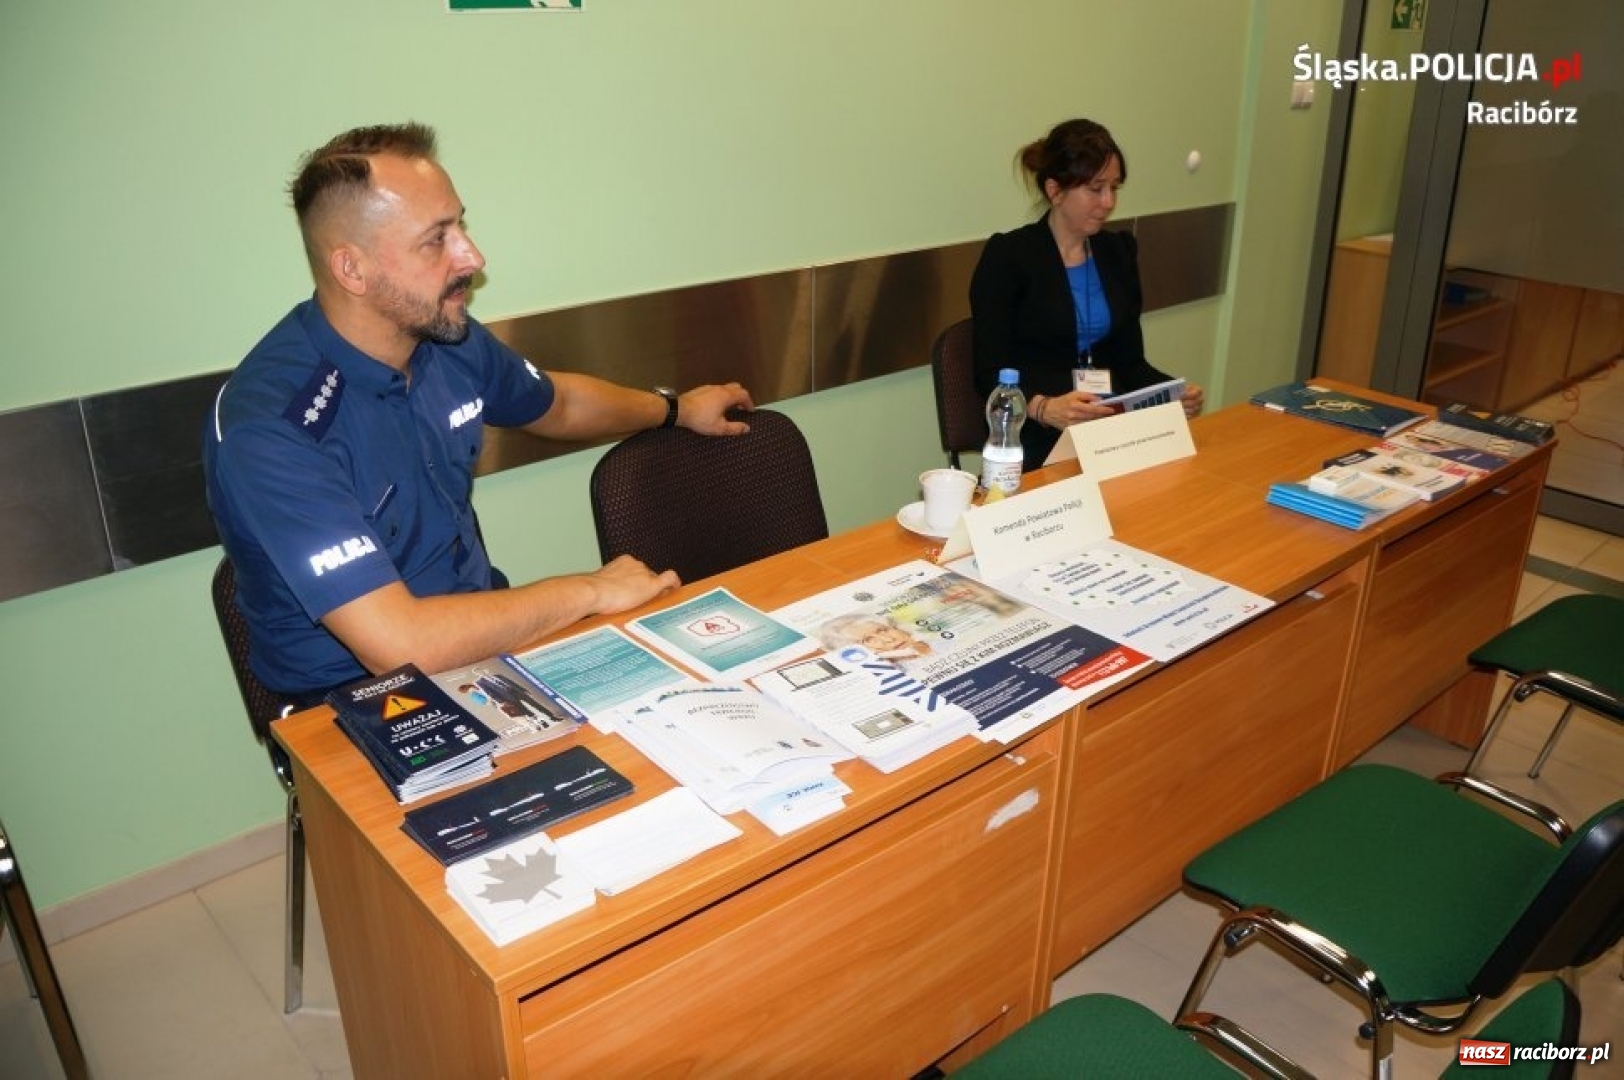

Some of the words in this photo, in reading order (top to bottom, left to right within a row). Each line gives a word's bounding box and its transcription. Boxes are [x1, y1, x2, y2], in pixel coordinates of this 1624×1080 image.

[994, 518, 1026, 535] Komenda
[1026, 505, 1063, 524] Powiatowa
[1031, 523, 1064, 539] Raciborzu
